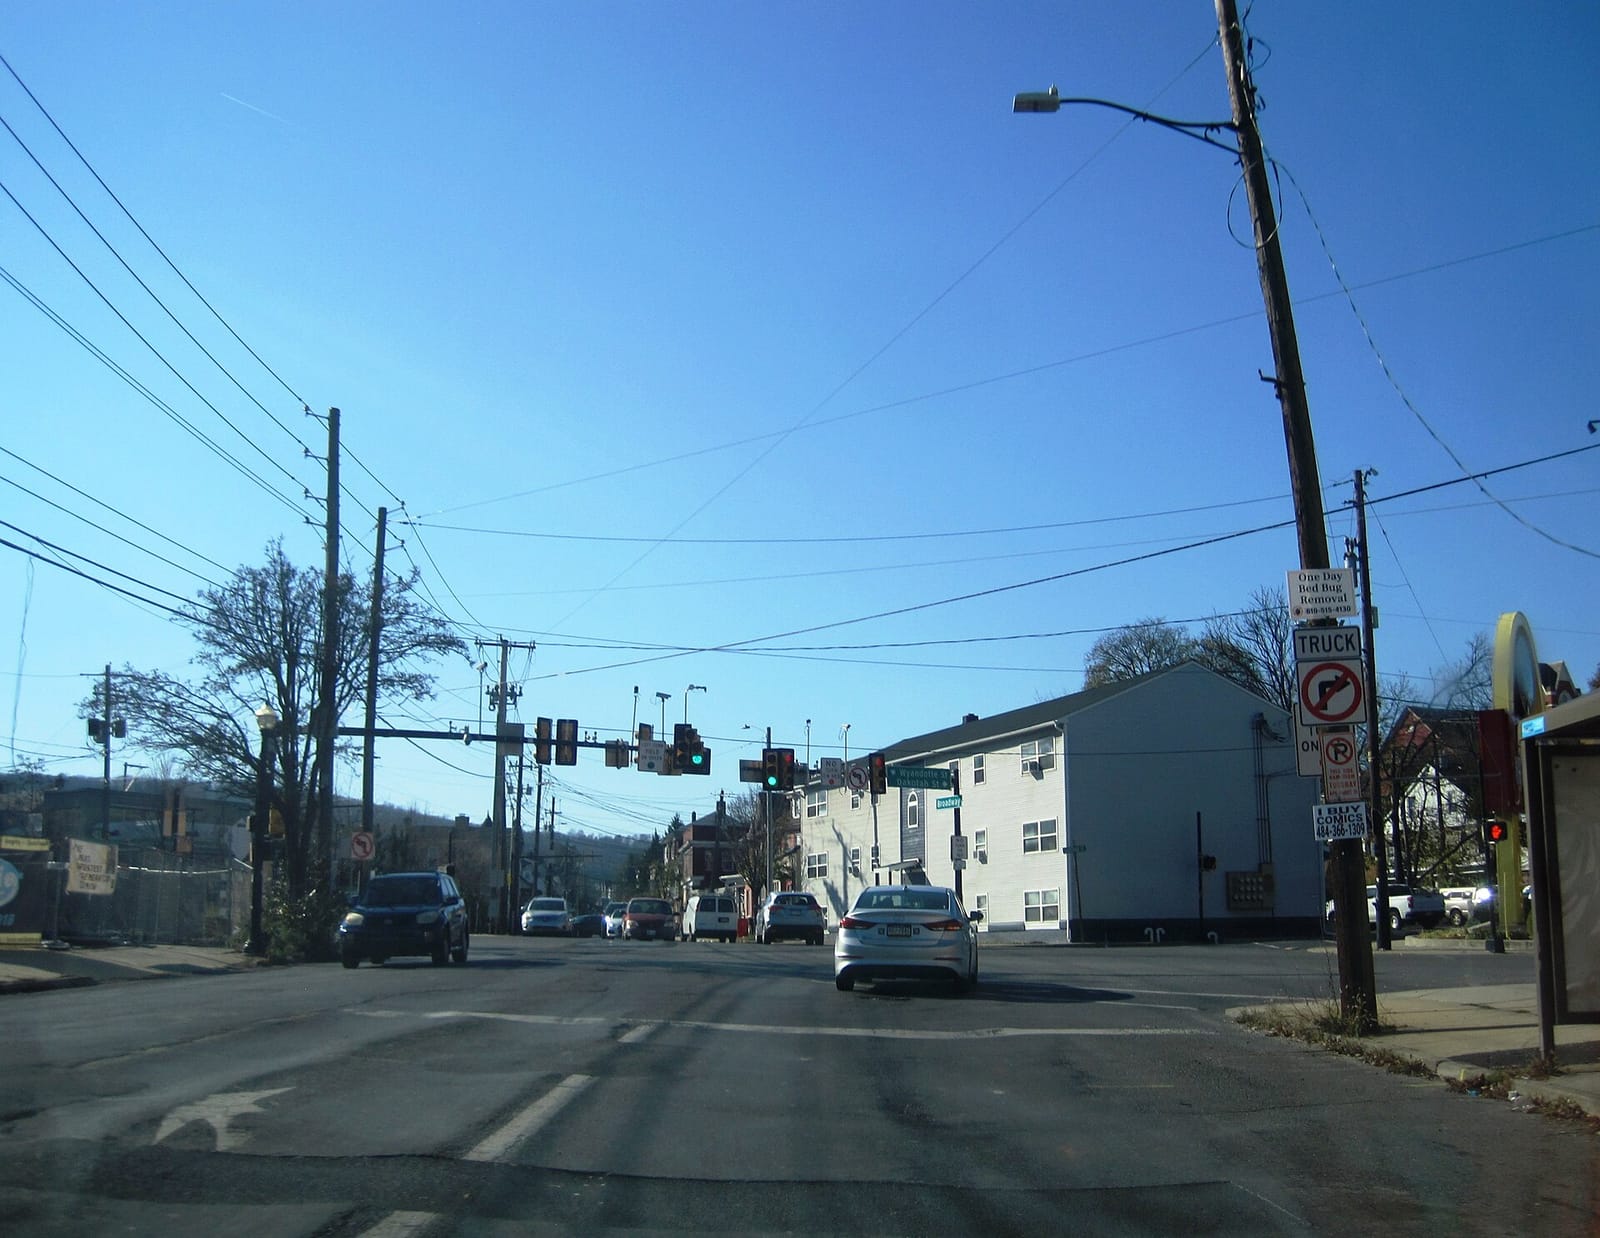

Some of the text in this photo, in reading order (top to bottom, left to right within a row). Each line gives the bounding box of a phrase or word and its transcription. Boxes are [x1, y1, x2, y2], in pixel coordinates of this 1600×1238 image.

[1298, 572, 1343, 582] One Day
[1298, 583, 1343, 593] Bed Bug
[1300, 593, 1347, 604] Removal
[1298, 633, 1356, 654] TRUCK
[1327, 805, 1360, 815] BUY
[1316, 814, 1363, 825] COMICS
